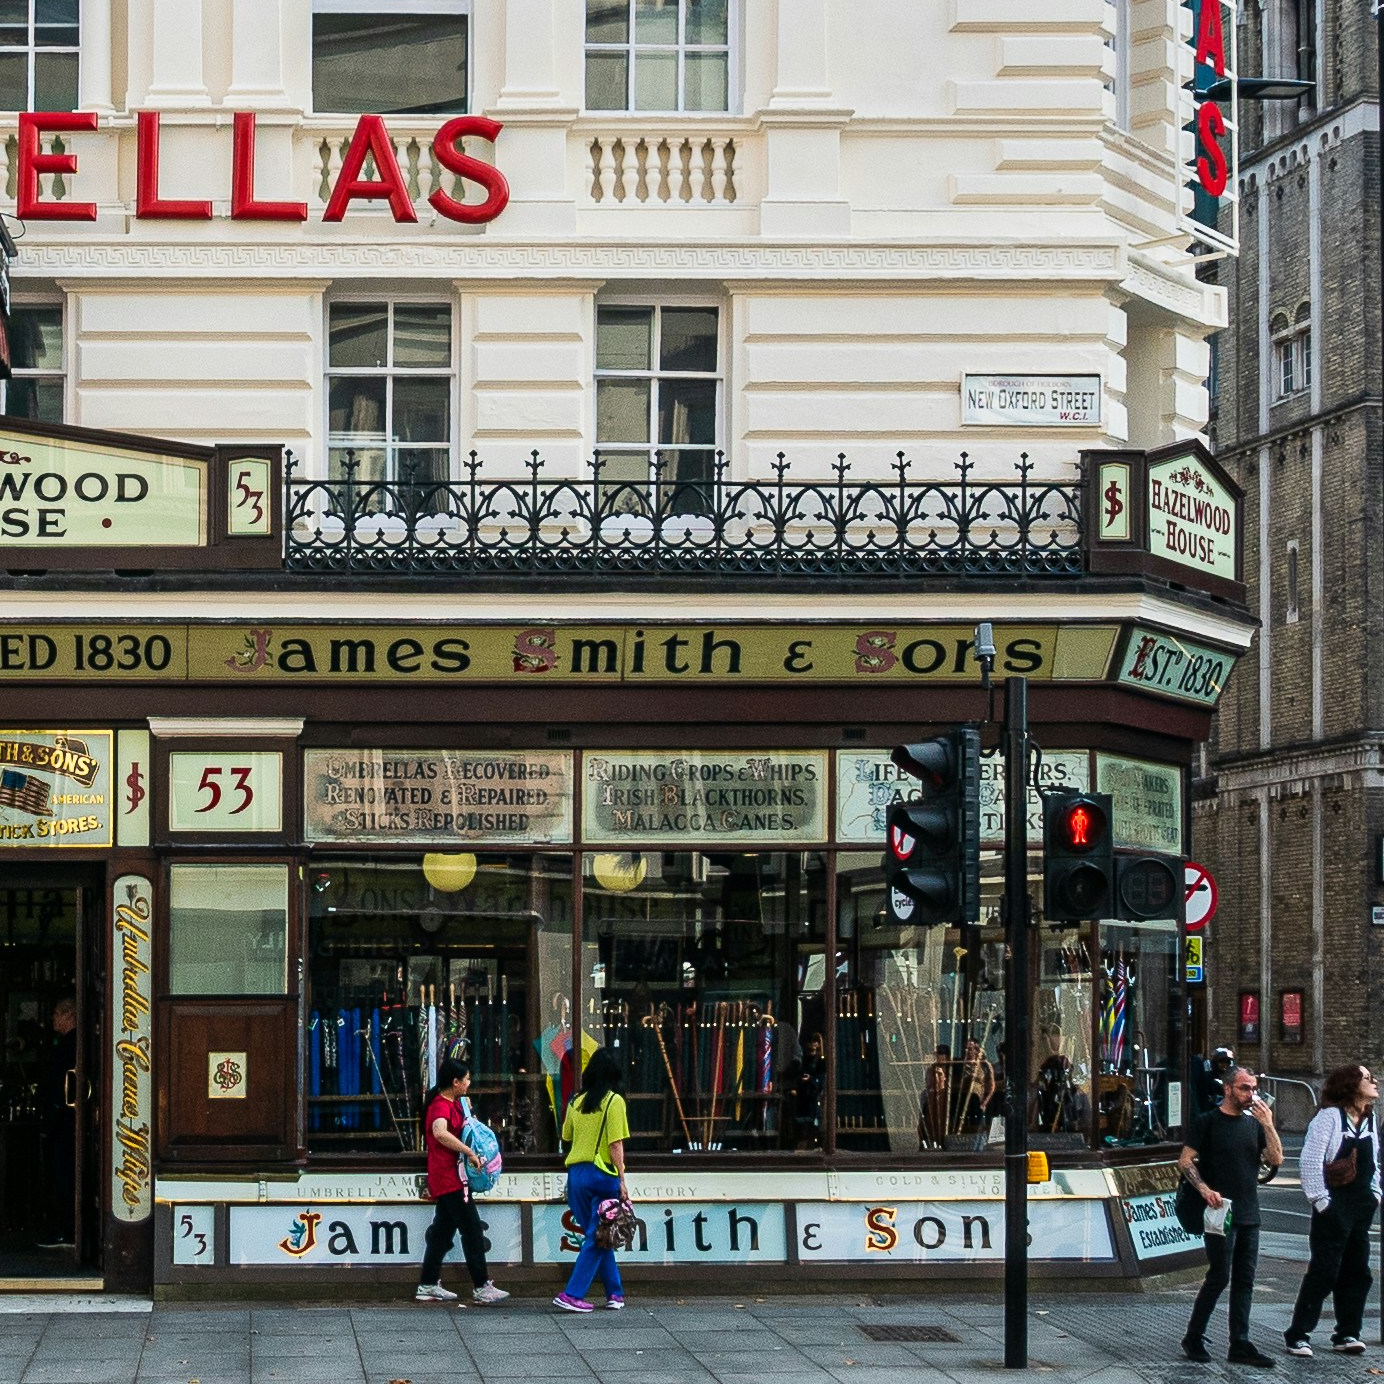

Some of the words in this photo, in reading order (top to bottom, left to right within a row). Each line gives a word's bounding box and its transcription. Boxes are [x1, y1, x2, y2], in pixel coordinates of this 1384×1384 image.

[968, 389, 994, 409] NEW
[998, 389, 1046, 410] OXFORD
[1051, 390, 1095, 410] STREET
[236, 471, 264, 525] 53
[1151, 478, 1231, 536] HAZELWOOD
[1165, 519, 1215, 566] HOUSE
[73, 634, 173, 672] 1830
[224, 629, 471, 674] James
[512, 629, 743, 674] Smith
[1178, 653, 1223, 698] 1830
[21, 745, 35, 762] &
[326, 756, 438, 780] UMBRELLAS
[442, 758, 550, 781] RECOVERED
[588, 757, 666, 783] RIDING
[669, 758, 734, 782] CROPS
[50, 794, 105, 805] AMERICAN
[194, 767, 253, 815] 53
[325, 783, 433, 805] RENOVATED
[602, 784, 655, 806] IRISH
[344, 807, 410, 831] STICKS
[415, 807, 530, 831] REPOLISHED
[612, 808, 716, 832] MALACCA
[296, 1187, 388, 1198] UMBRELLA
[631, 1186, 699, 1197] ACTORY
[875, 1175, 922, 1186] GOLD
[949, 1174, 1006, 1186] SILVE
[1123, 1201, 1158, 1224] James
[180, 1214, 207, 1256] 53
[864, 1205, 1033, 1256] Son
